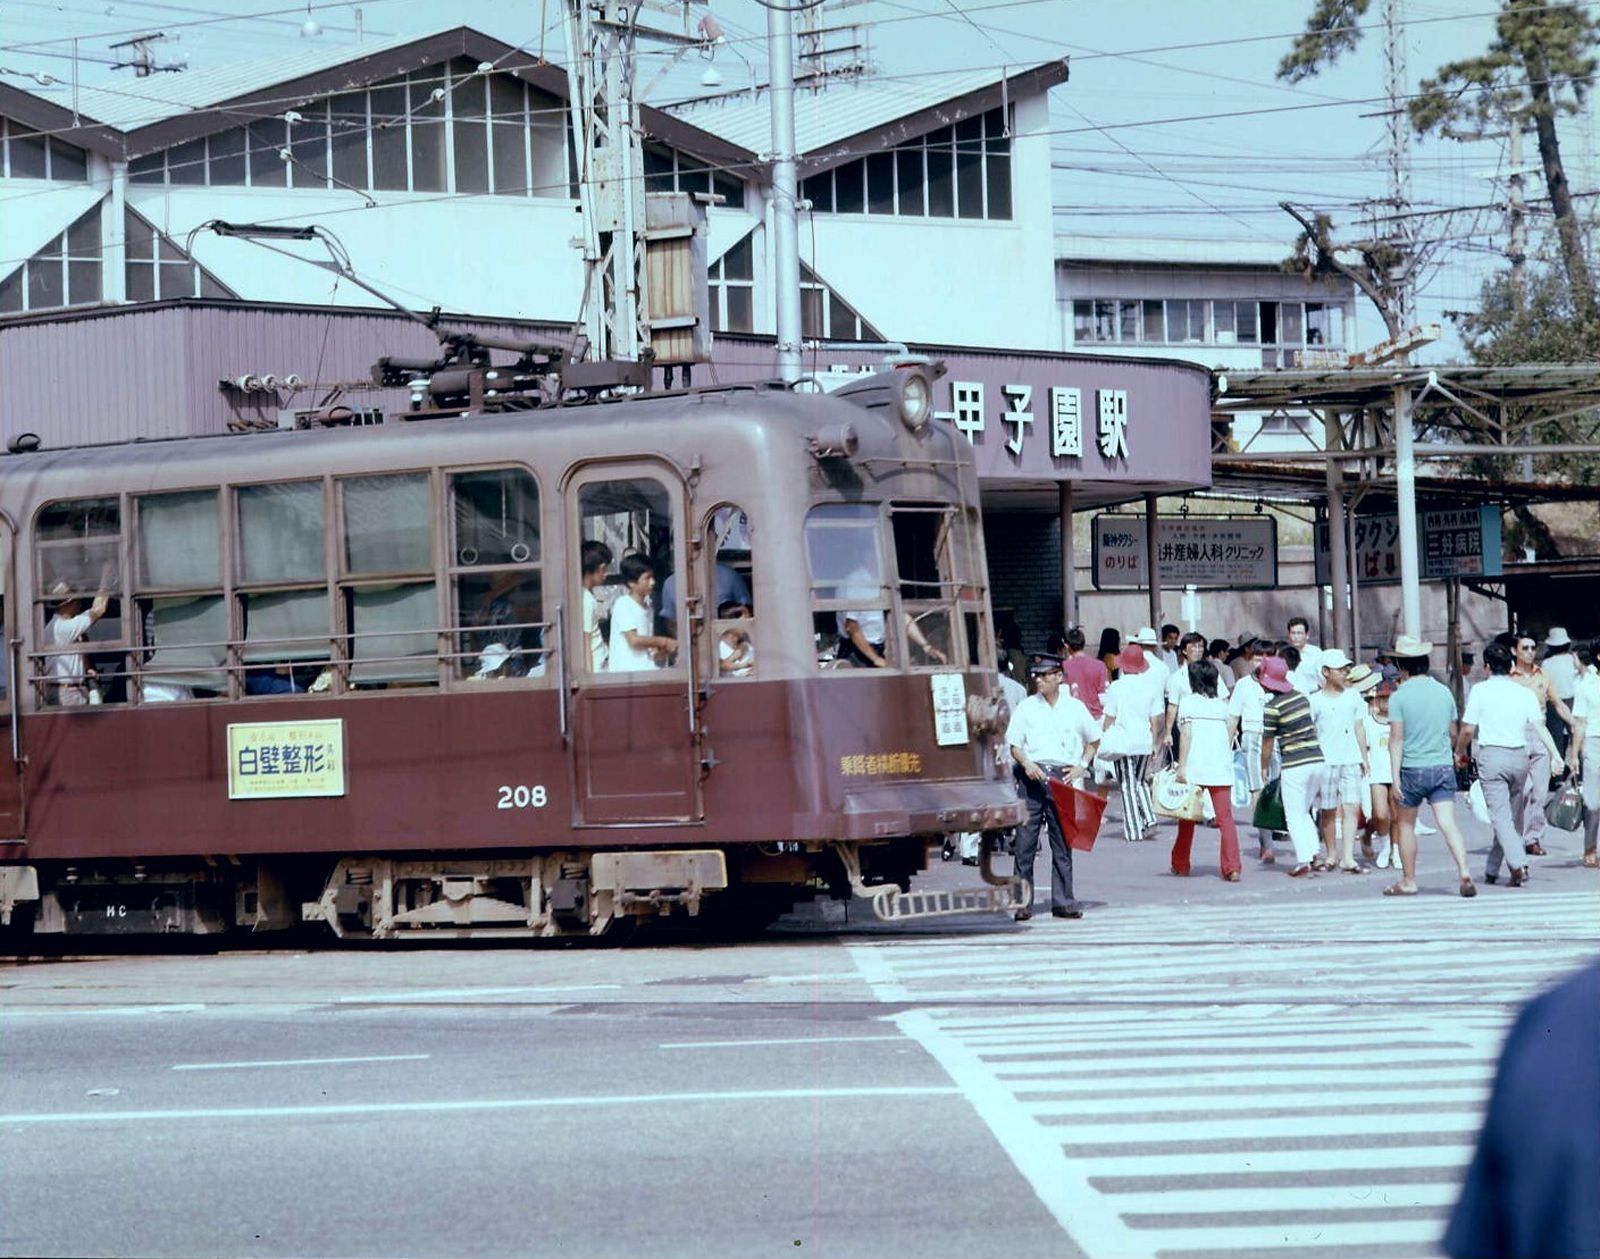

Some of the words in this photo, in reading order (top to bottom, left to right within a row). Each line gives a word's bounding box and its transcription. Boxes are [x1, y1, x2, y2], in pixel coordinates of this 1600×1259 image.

[953, 381, 1129, 458] 甲子園駅
[1428, 531, 1481, 556] 三好病院
[1105, 555, 1137, 569] のりば
[239, 744, 325, 775] 白壁整形
[497, 785, 547, 808] 208
